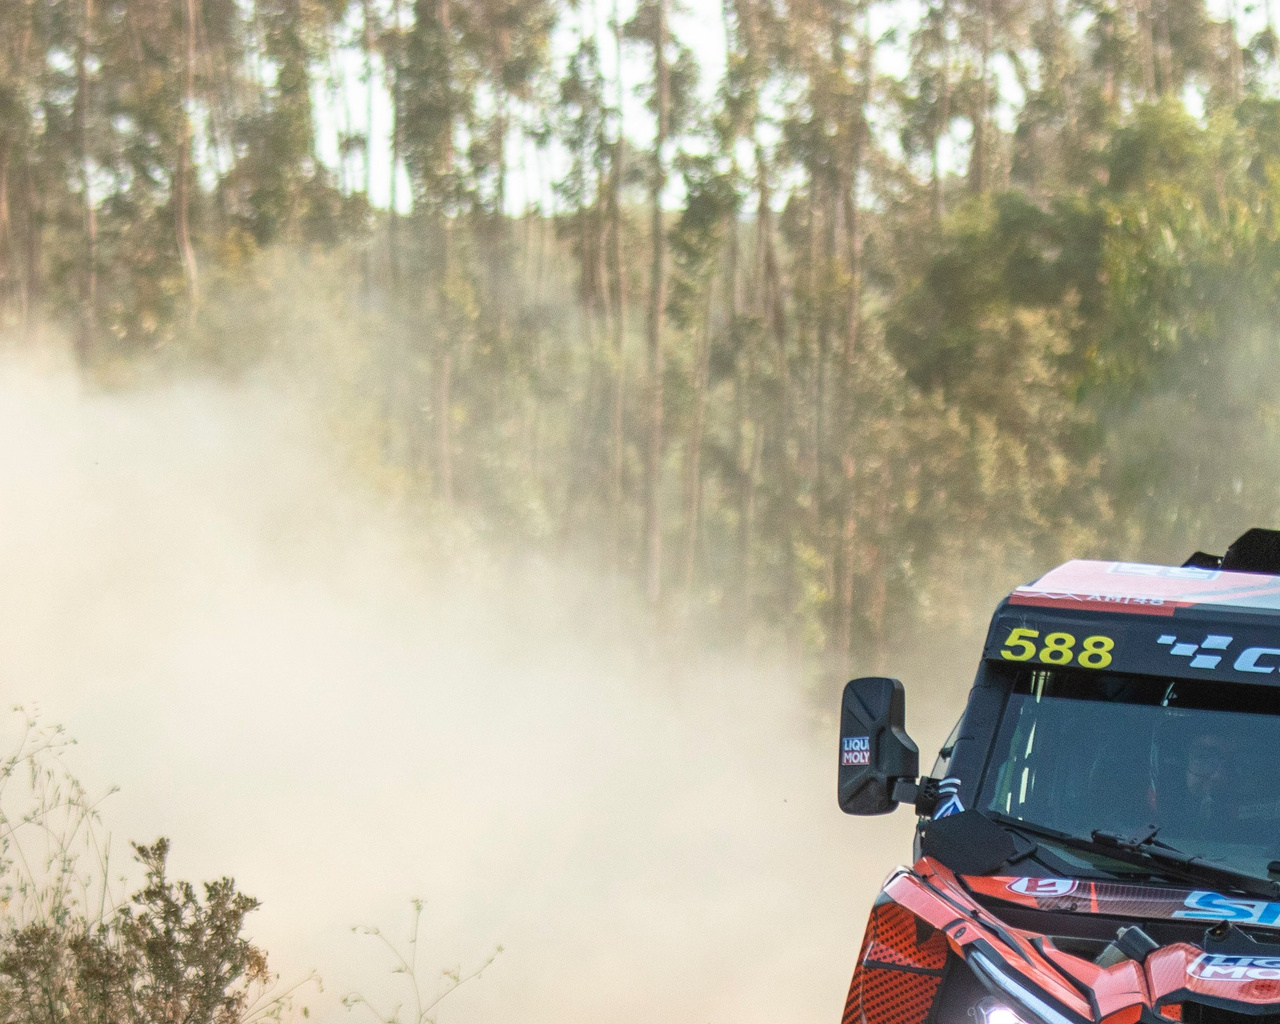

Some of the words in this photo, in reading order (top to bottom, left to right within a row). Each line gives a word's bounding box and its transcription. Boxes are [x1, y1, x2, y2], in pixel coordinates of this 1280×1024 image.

[1000, 627, 1115, 670] 588
[842, 738, 869, 751] LIQUI
[842, 751, 870, 764] MOLY
